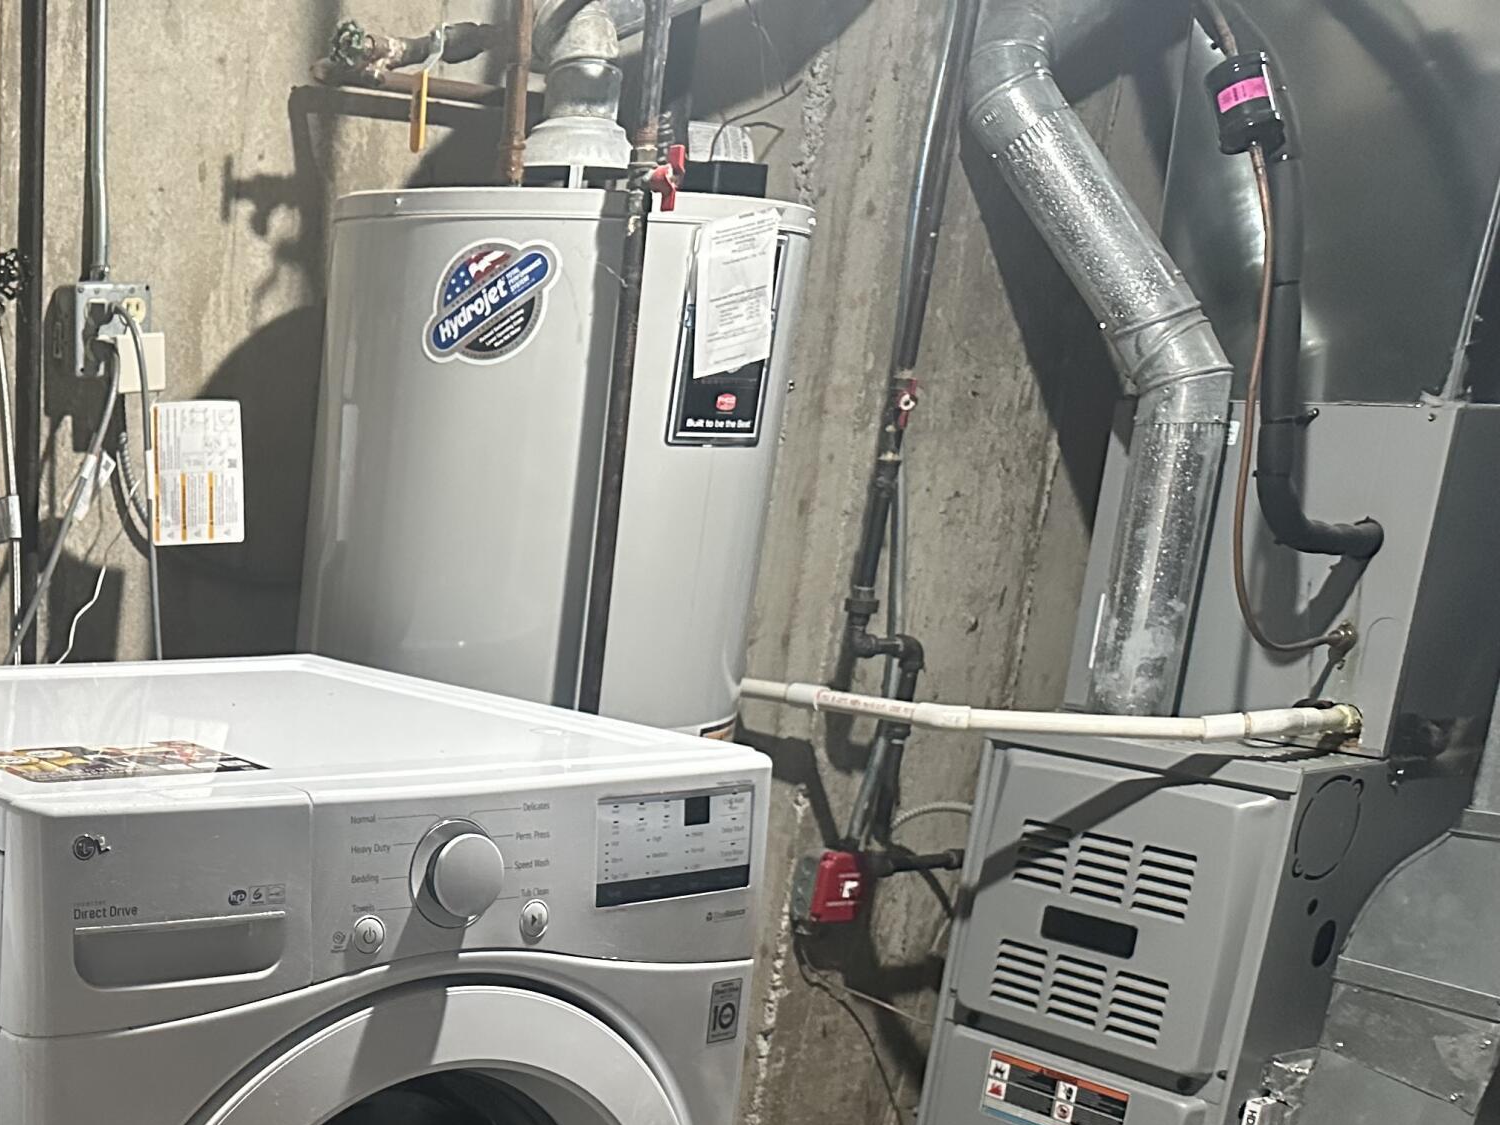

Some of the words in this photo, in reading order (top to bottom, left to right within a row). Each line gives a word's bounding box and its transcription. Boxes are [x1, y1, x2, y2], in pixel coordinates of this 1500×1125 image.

[438, 278, 508, 343] Hydrojet
[686, 418, 704, 427] Built
[706, 419, 713, 427] to
[715, 420, 724, 428] be
[726, 420, 736, 428] the
[523, 802, 549, 811] Delicates
[351, 815, 376, 824] Normal
[534, 830, 550, 839] Press
[351, 844, 372, 854] Heavy
[374, 843, 390, 853] Duty
[514, 860, 532, 870] Speed
[534, 859, 549, 868] Wash
[351, 874, 379, 884] Bedding
[74, 906, 106, 920] Direct
[110, 905, 138, 918] Drive
[352, 904, 375, 912] Towels
[712, 1001, 736, 1032] 10
